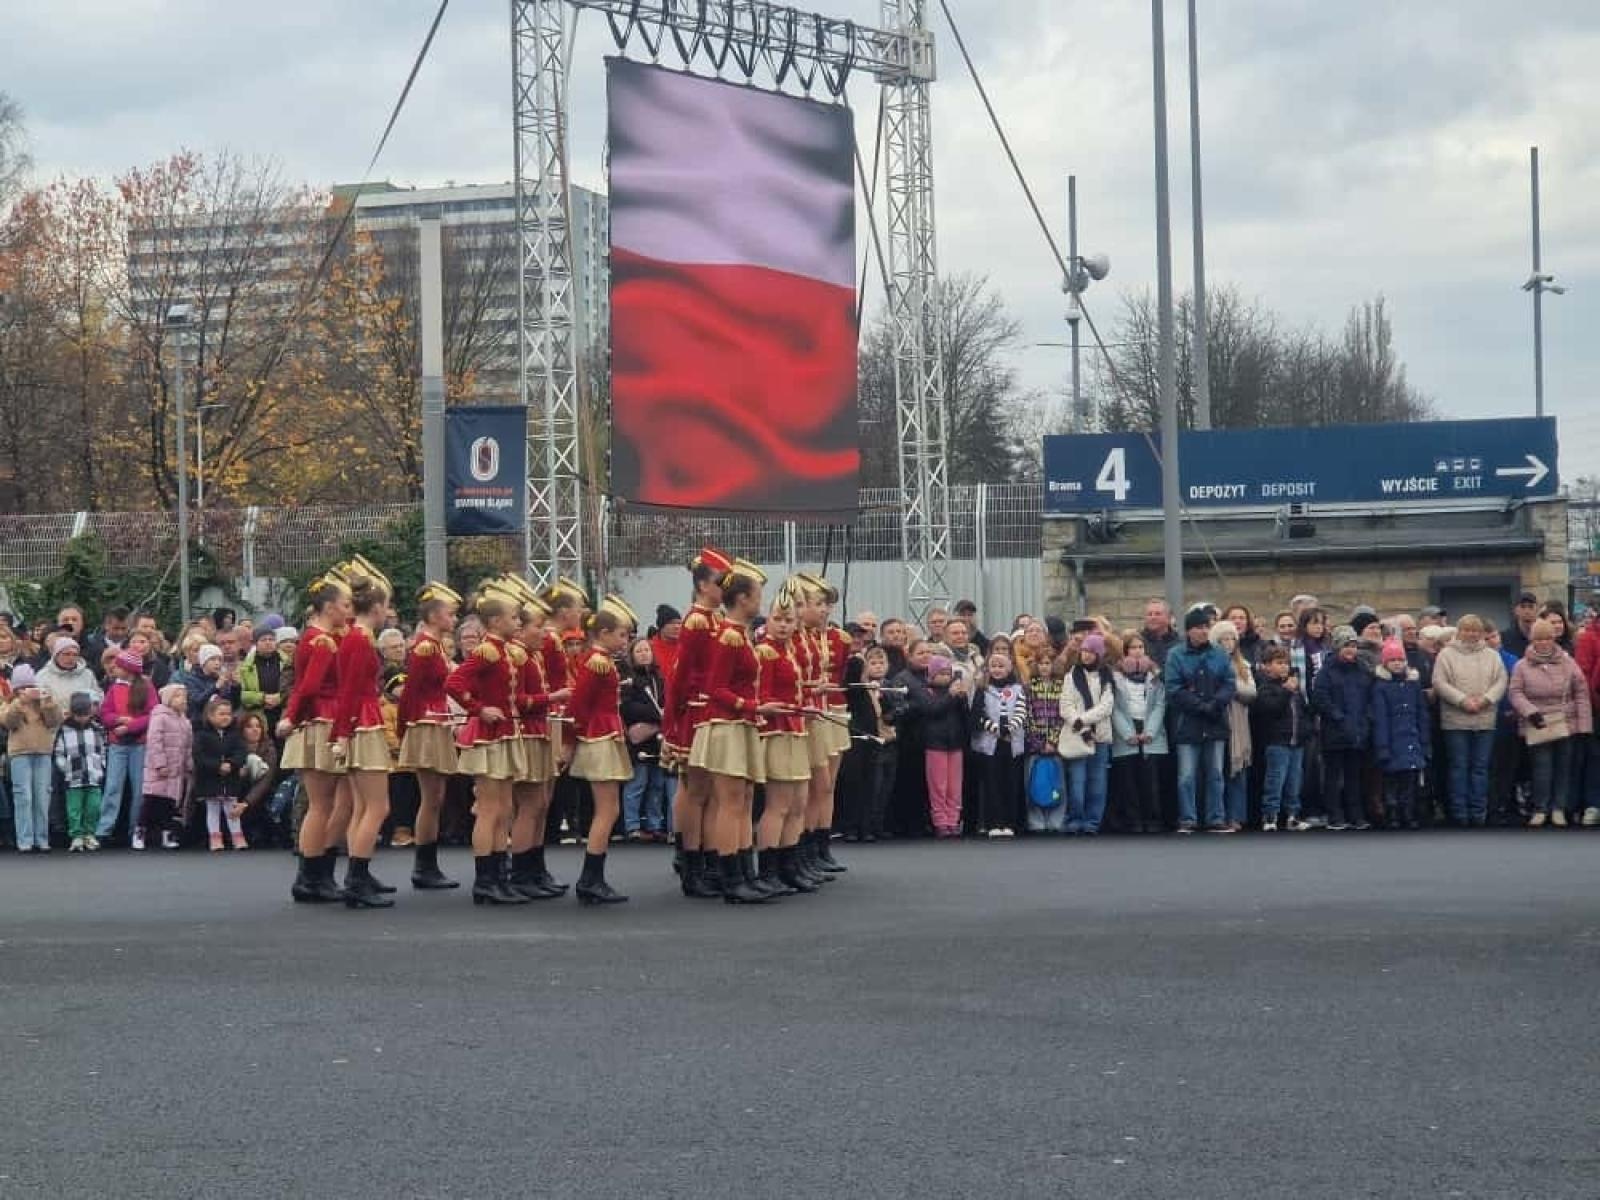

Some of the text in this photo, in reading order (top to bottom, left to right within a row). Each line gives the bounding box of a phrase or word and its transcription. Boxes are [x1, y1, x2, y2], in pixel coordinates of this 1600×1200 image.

[1048, 447, 1131, 500] Brama 4
[1190, 480, 1317, 499] DEPOZYT DEPOSIT
[1381, 475, 1482, 493] WYJŚCIE EXIT
